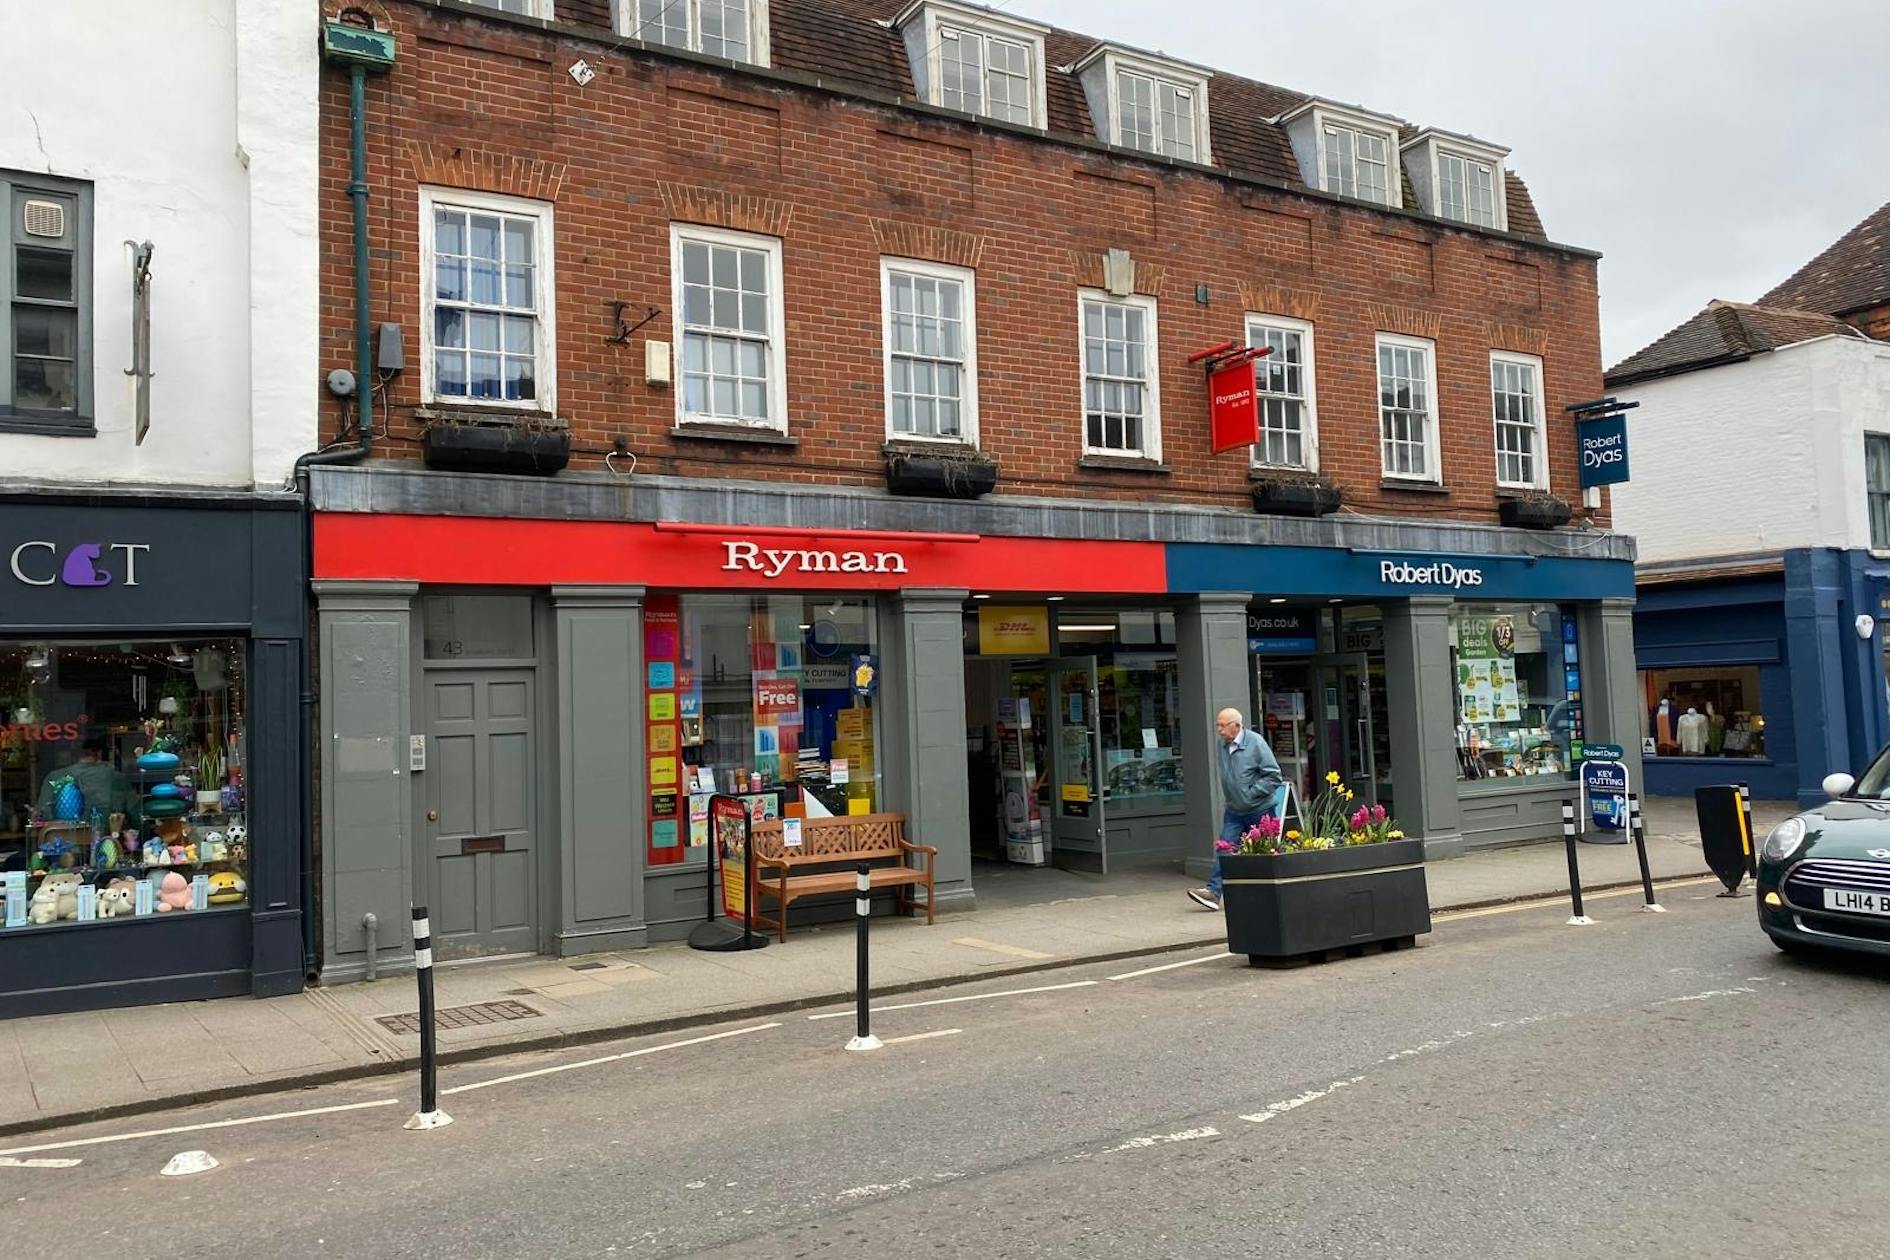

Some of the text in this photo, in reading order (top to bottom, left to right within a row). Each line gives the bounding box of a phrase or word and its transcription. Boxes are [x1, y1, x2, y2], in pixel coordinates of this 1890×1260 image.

[1216, 390, 1250, 404] Ryman
[1583, 433, 1621, 449] Robert
[1583, 449, 1623, 468] Dyas
[721, 541, 908, 577] Ryman
[1381, 561, 1482, 589] Robert Dyas
[1462, 619, 1487, 636] BIG
[1496, 626, 1511, 640] 1/3
[442, 641, 463, 655] 43
[1347, 634, 1371, 648] BIG
[1463, 637, 1487, 647] deals
[811, 669, 847, 677] CUTTING
[759, 690, 796, 705] Free
[1604, 750, 1619, 758] Dyas
[1597, 770, 1613, 778] KEY
[1588, 777, 1624, 786] CUTTING
[717, 802, 744, 815] Ryman
[1592, 803, 1612, 812] FREE
[1835, 891, 1874, 910] LH14
